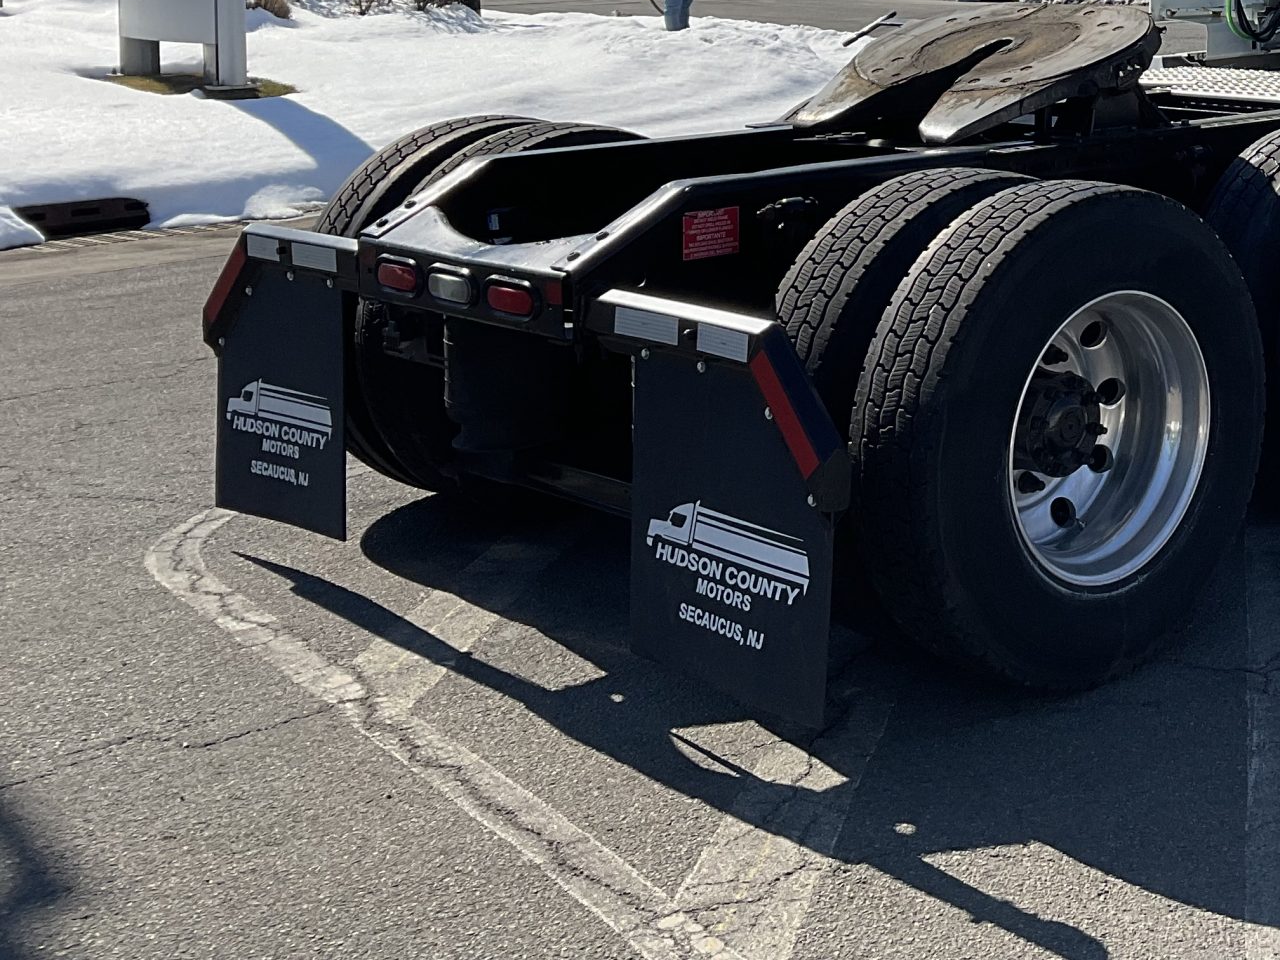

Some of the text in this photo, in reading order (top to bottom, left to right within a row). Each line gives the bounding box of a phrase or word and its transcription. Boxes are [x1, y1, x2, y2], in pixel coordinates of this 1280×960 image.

[233, 415, 327, 450] HUDSON COUNTY
[262, 438, 300, 459] MOTORS
[250, 460, 309, 487] SECAUCUS, NJ
[655, 542, 801, 606] HUDSON COUNTY
[695, 577, 752, 612] MOTORS
[678, 602, 765, 650] SECAUCUS, NJ
